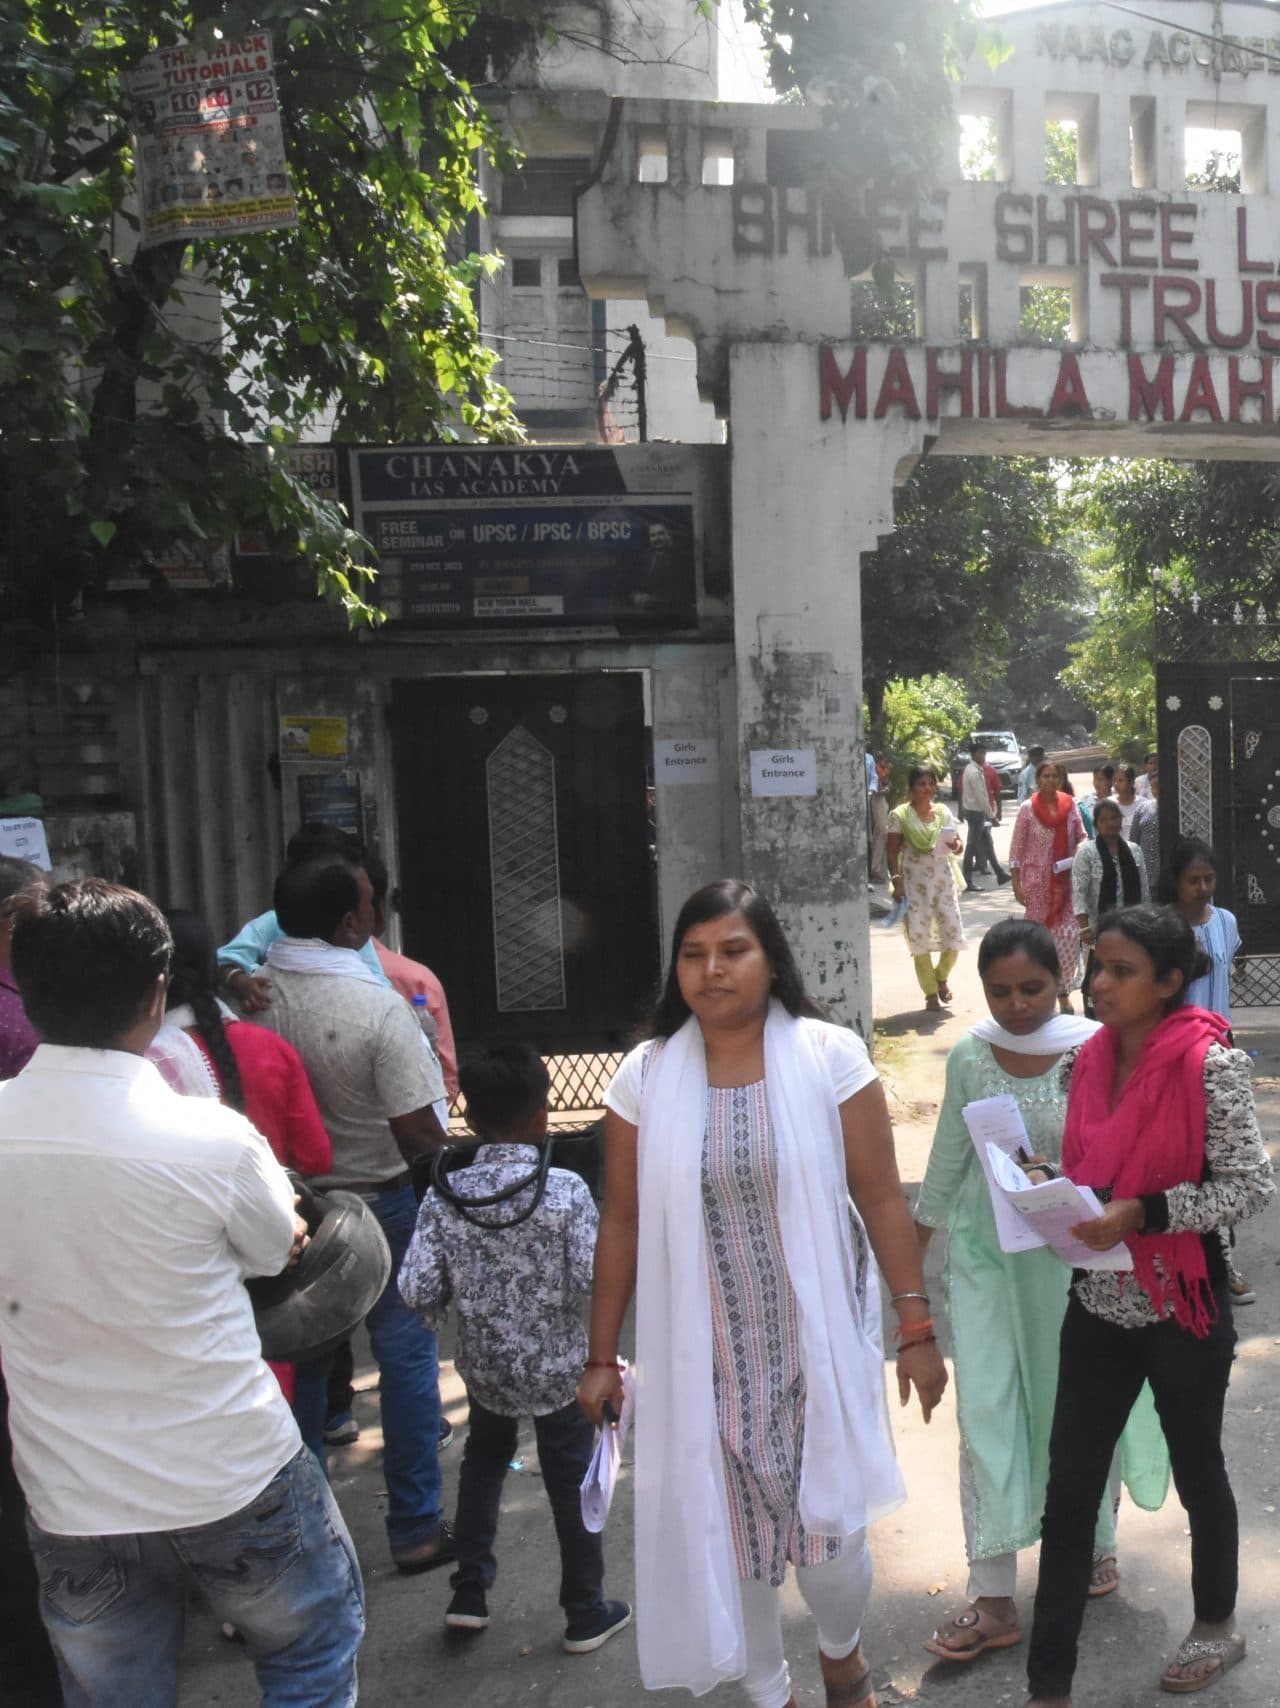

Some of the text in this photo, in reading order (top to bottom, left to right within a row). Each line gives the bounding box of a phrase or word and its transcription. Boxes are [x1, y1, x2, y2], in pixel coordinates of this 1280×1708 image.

[163, 56, 268, 84] TUTORIALS
[250, 82, 273, 100] 12
[733, 183, 950, 259] SHEE
[996, 193, 1199, 270] SHREE
[819, 346, 1092, 422] MAHILA
[386, 454, 581, 478] CHANAKYA
[410, 479, 563, 496] IAS ACADEMY
[380, 521, 418, 535] FREE
[473, 524, 516, 543] UPSC
[533, 522, 571, 541] JPSC
[587, 520, 632, 540] BPSC
[382, 535, 444, 549] SEMINAR
[674, 743, 696, 752] Girls
[665, 757, 707, 766] Entrance
[771, 754, 795, 764] Girls
[761, 769, 805, 778] Entrance
